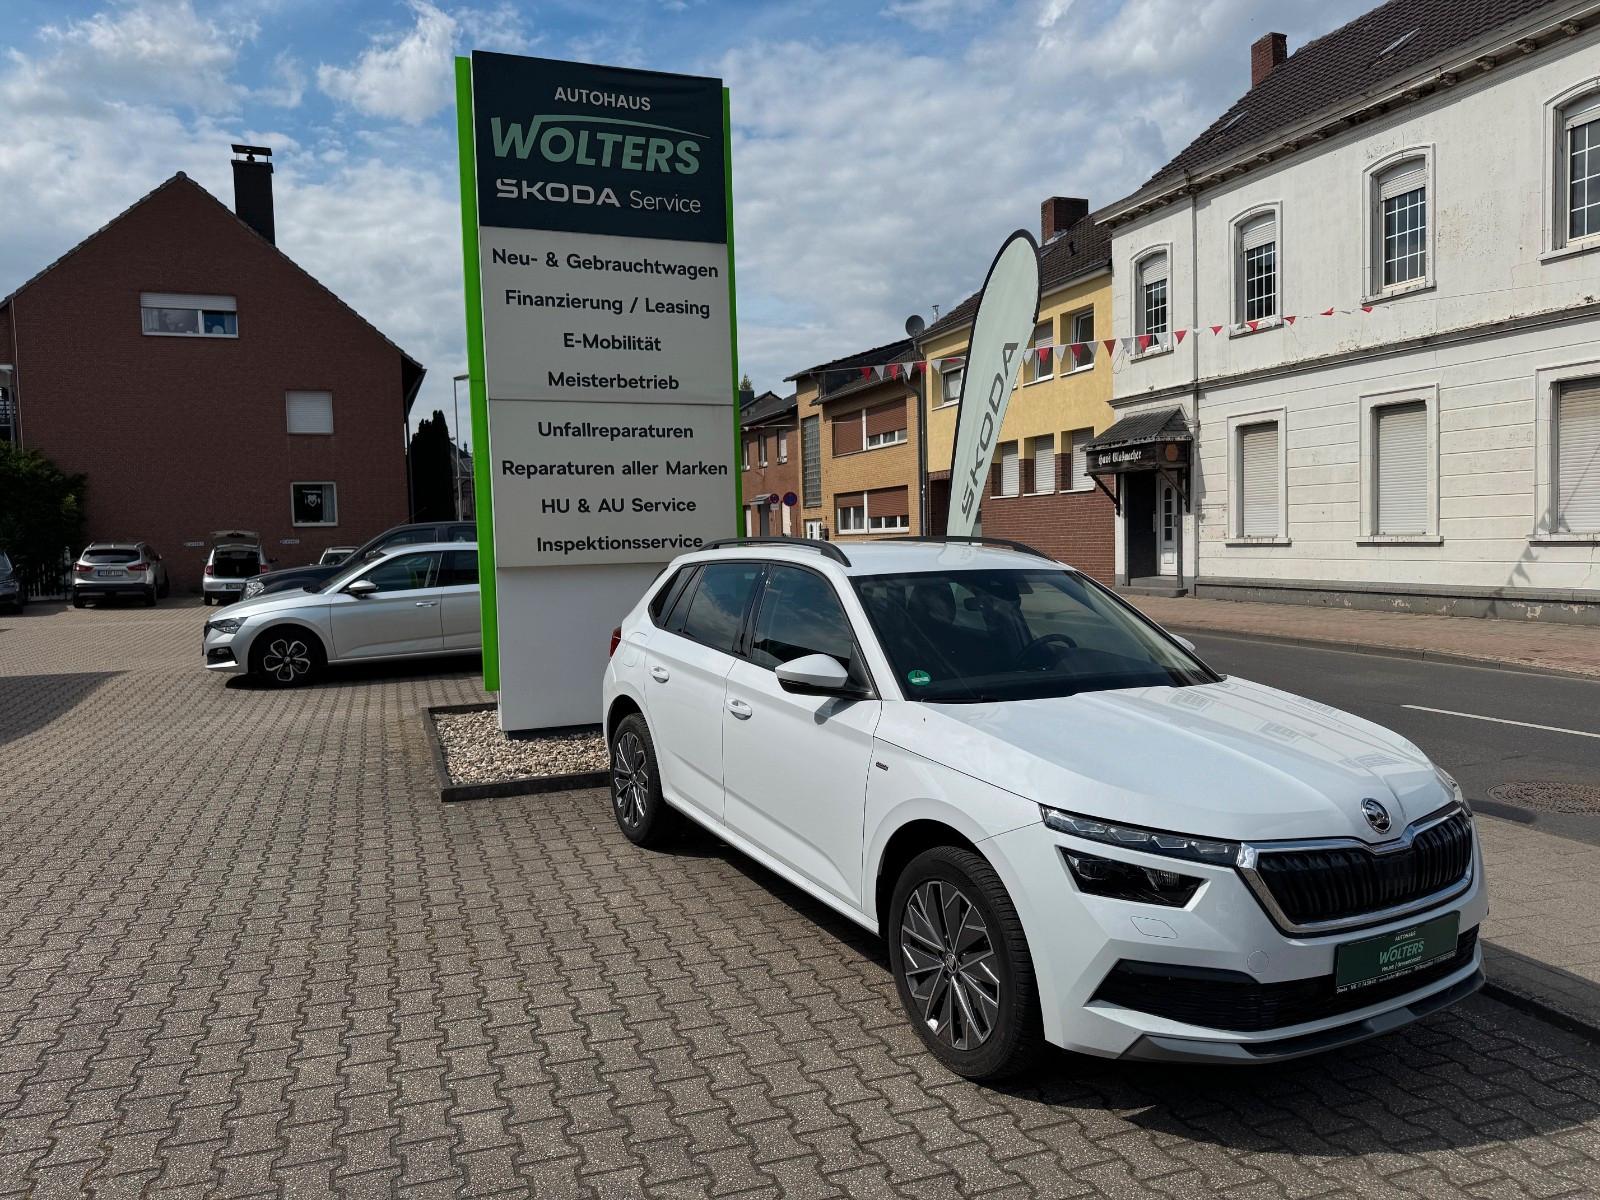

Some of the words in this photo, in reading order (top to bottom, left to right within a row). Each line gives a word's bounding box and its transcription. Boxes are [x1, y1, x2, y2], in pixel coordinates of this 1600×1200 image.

[554, 86, 651, 111] AUTOHAUS
[490, 114, 702, 175] WOLTERS
[630, 190, 701, 213] Service
[492, 248, 538, 266] Neu-
[545, 252, 559, 268] &
[566, 253, 719, 280] Gebrauchtwagen
[505, 289, 623, 315] Finanzierung
[629, 297, 639, 314] /
[645, 297, 711, 319] Leasing
[563, 332, 662, 352] E-Mobilität
[548, 371, 680, 390] Meisterbetrieb
[537, 421, 694, 441] Unfallreparaturen
[502, 460, 615, 479] Reparaturen
[621, 460, 659, 475] aller
[665, 460, 728, 476] Marken
[541, 498, 570, 514] HU
[577, 498, 591, 513] &
[598, 498, 625, 513] AU
[631, 498, 697, 513] Service
[537, 534, 703, 555] Inspektionsservice
[1379, 938, 1425, 964] WOLTERS
